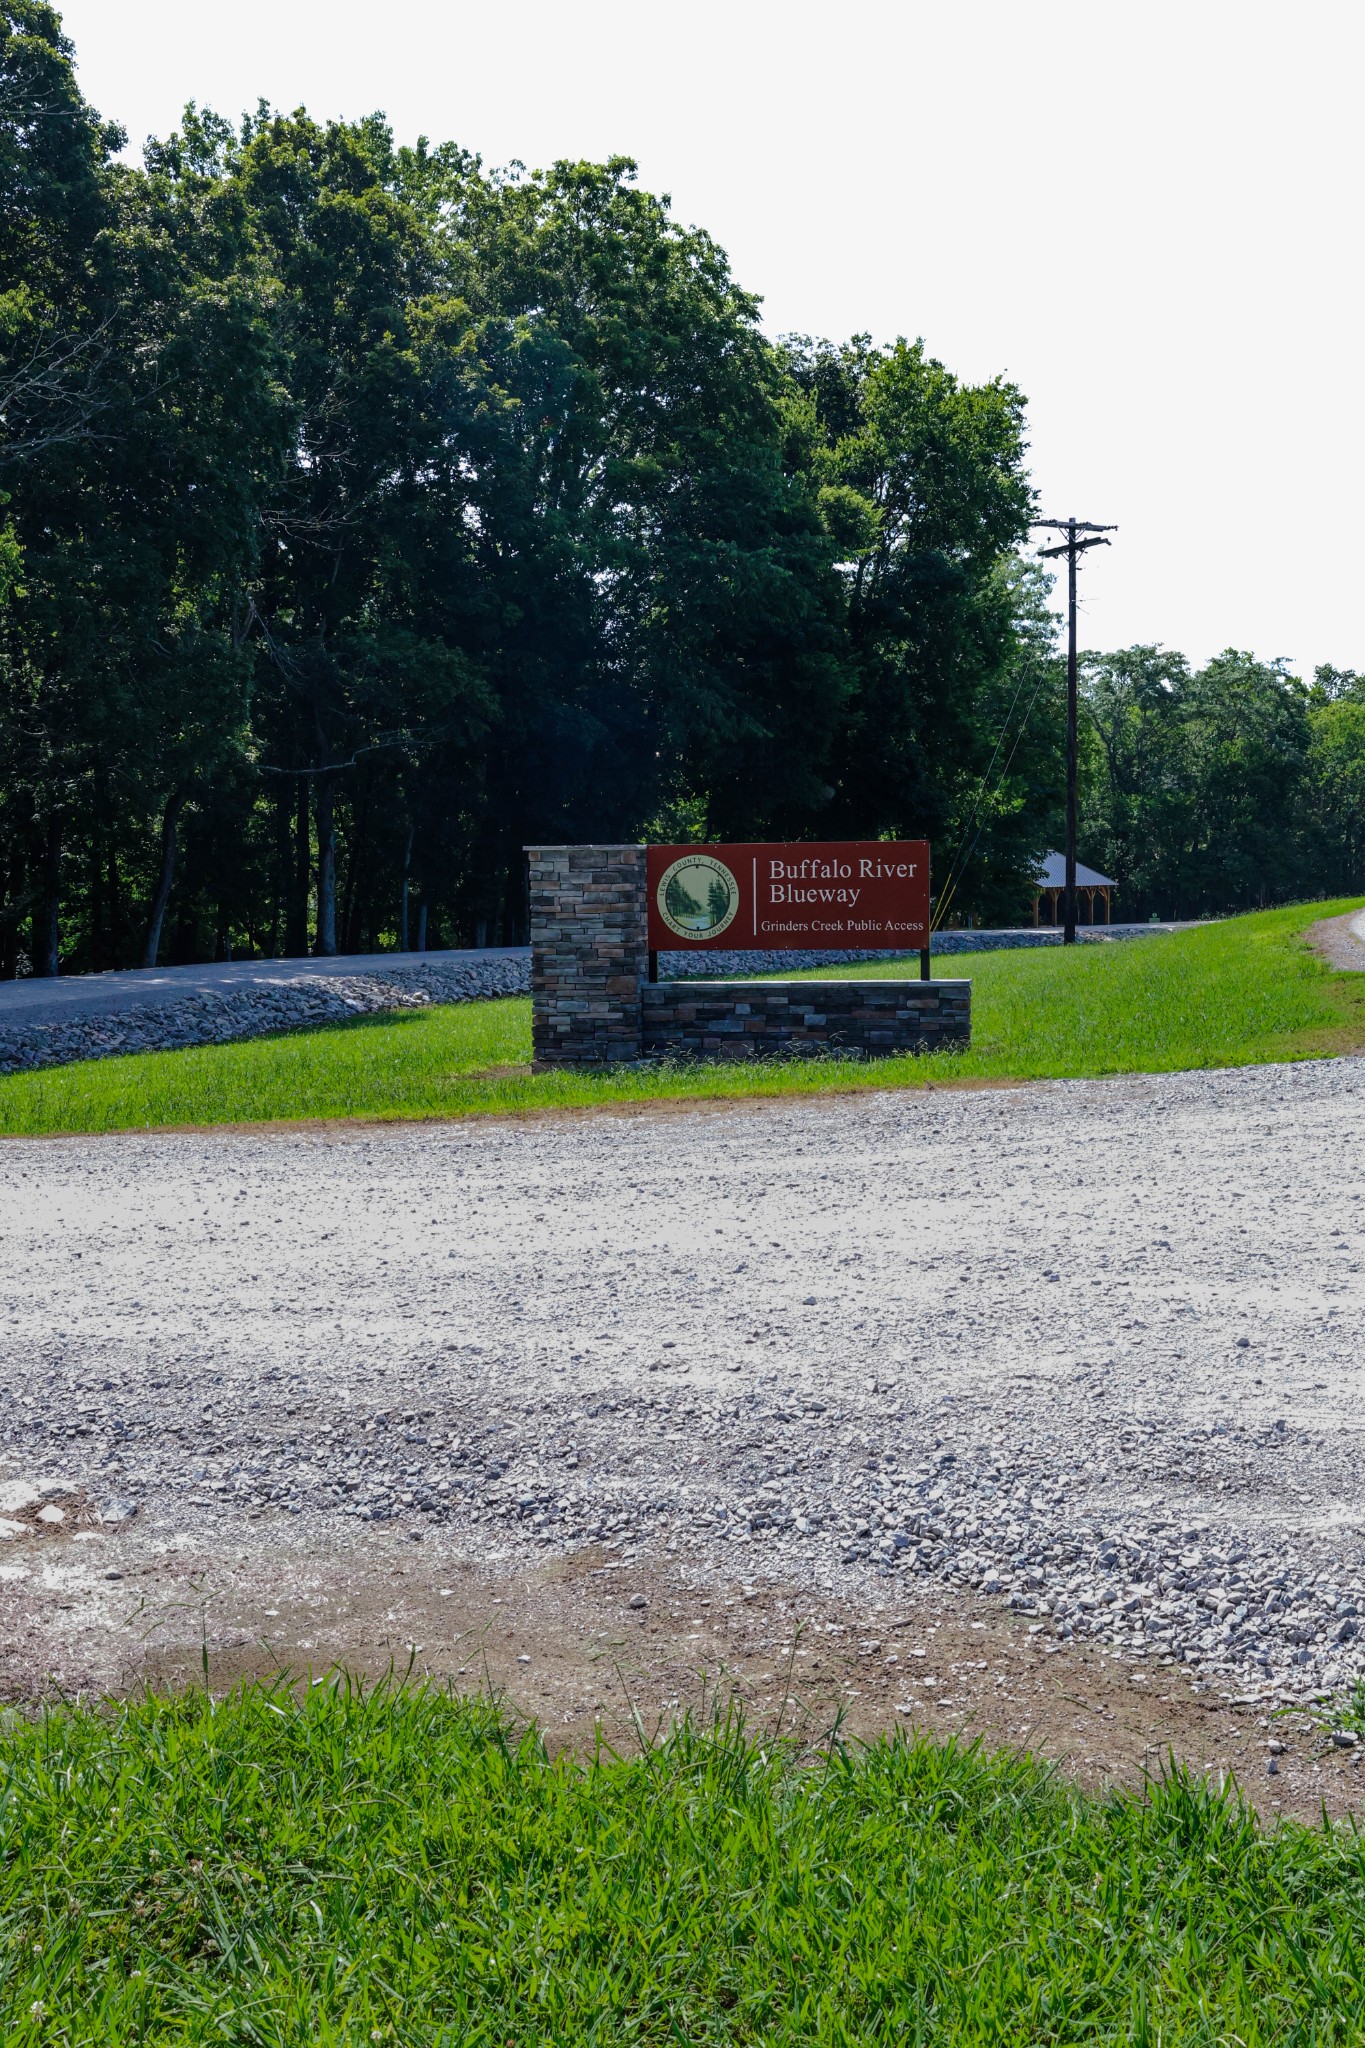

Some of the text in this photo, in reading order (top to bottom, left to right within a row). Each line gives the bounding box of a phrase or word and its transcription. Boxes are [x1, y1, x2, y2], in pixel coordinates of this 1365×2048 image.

[659, 874, 671, 896] LEWIS
[709, 859, 736, 895] TENNESSEE
[769, 858, 917, 879] Buffalo River
[769, 884, 861, 907] Blueway
[662, 911, 734, 939] CHART YOUR JOURNEY
[761, 919, 924, 931] Grinders Creek Public Access
